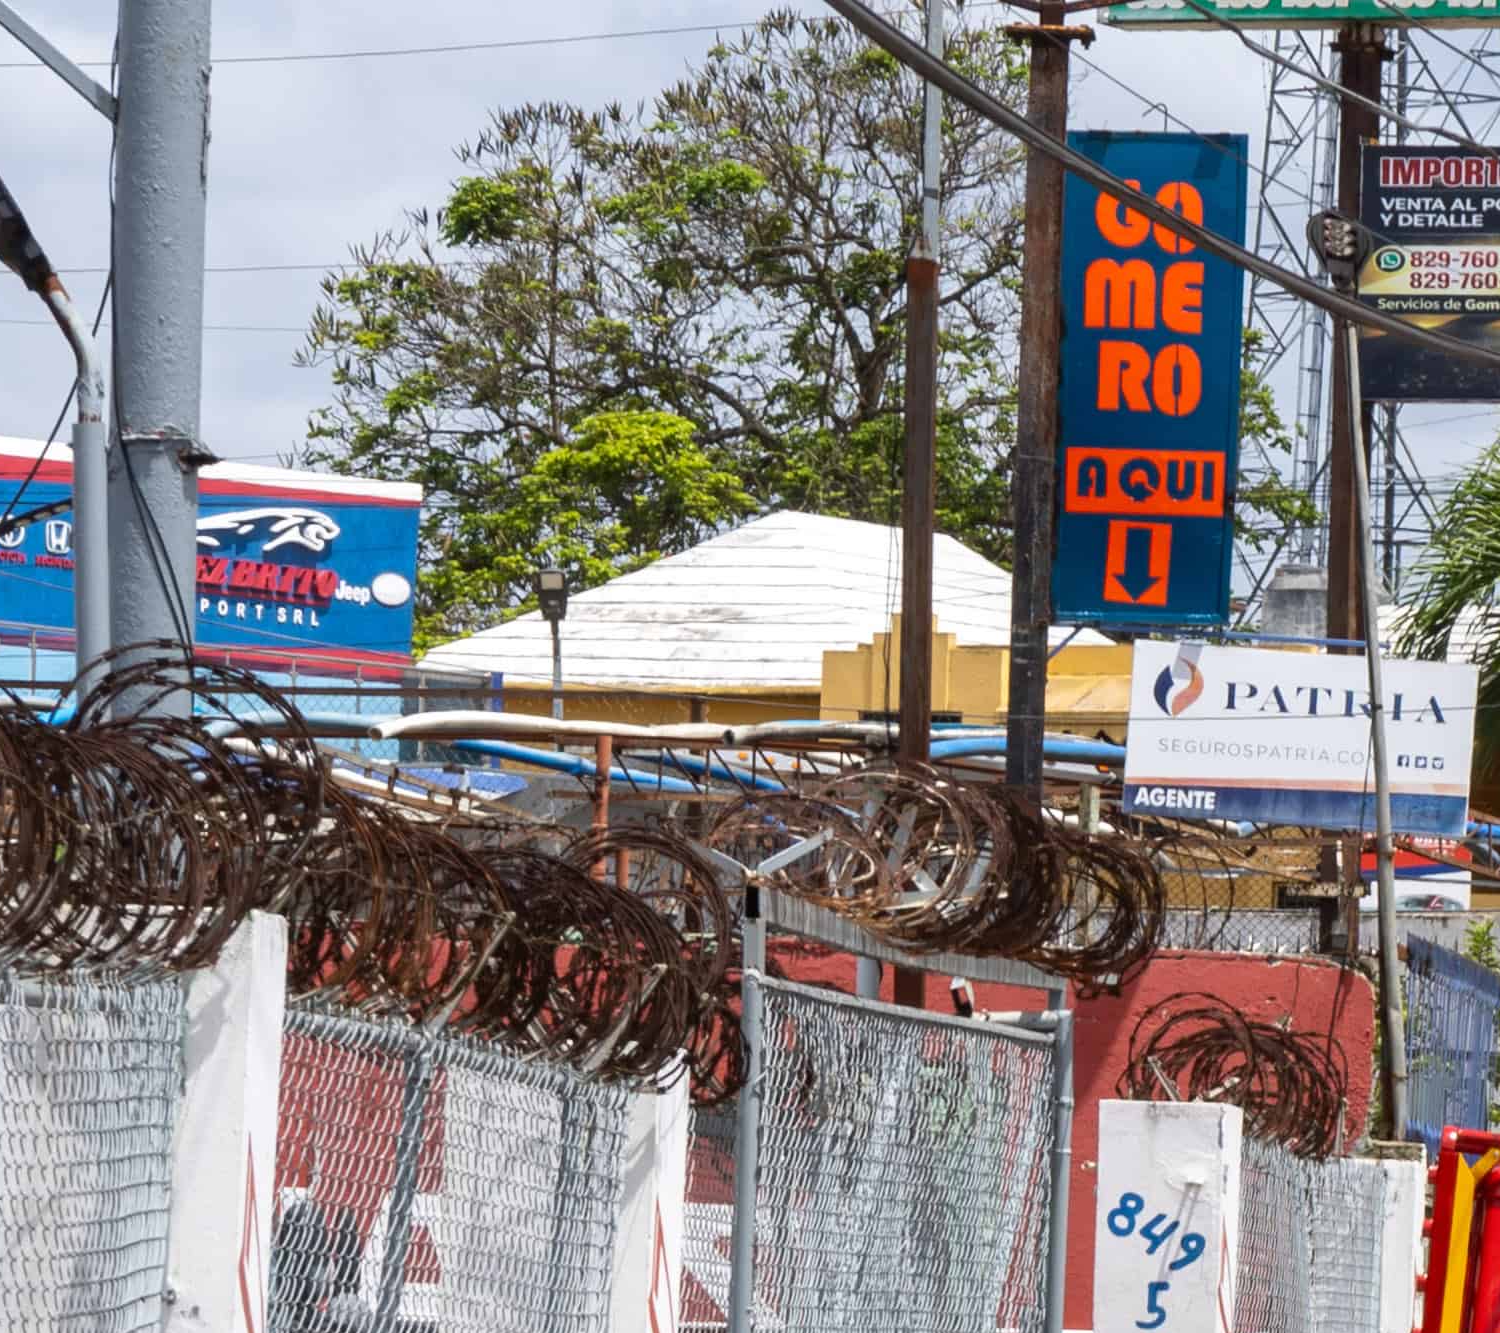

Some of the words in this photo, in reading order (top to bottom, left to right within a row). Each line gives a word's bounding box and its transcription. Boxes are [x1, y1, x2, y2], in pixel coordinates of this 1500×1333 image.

[1380, 197, 1442, 212] VENTA
[1450, 198, 1479, 212] AL
[1380, 213, 1392, 228] Y
[1398, 213, 1484, 228] DETALLE
[1084, 258, 1204, 334] ME
[1377, 297, 1440, 313] Servicios
[1442, 299, 1462, 312] de
[1097, 340, 1203, 417] RO
[1077, 456, 1216, 503] AQUI
[233, 560, 339, 600] BRITO
[335, 579, 370, 606] Jeep
[200, 597, 264, 620] PORT
[277, 607, 320, 627] SRL
[1158, 736, 1372, 767] SEGUROSPATRIA.CO
[1133, 786, 1217, 810] AGENTE
[1107, 1191, 1206, 1271] 849
